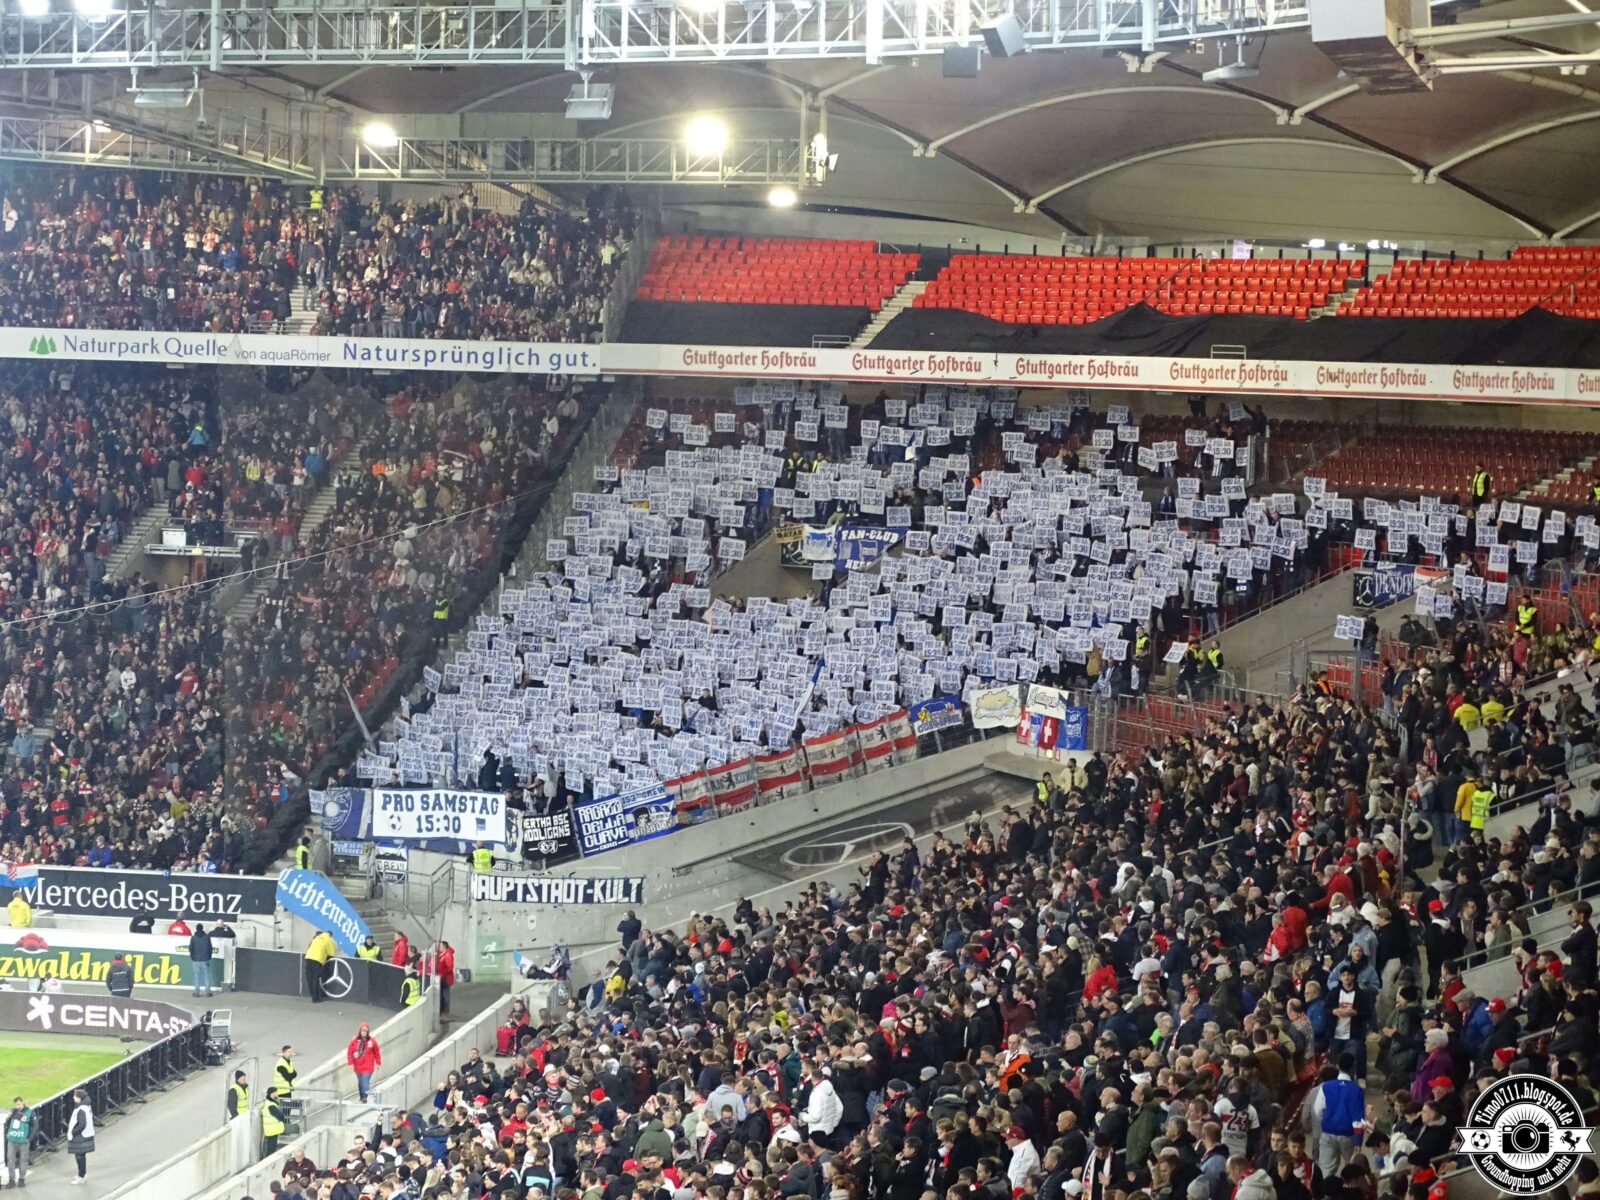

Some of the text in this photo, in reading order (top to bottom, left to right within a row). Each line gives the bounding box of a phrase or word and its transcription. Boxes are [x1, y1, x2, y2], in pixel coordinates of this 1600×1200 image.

[64, 334, 228, 358] Naturpark Quelle
[234, 346, 332, 364] von aquaRömer
[343, 339, 597, 372] Natursprünglich gut.
[683, 348, 816, 370] Stuttgarter Hofbräu
[852, 352, 982, 375] Stuttgarter Hofbräu
[1016, 358, 1138, 380] Stuttgarter Hofbräu
[1170, 362, 1288, 385] Stuttgarter Hofbräu
[1316, 366, 1426, 388] Stuttgarter Hofbräu
[1453, 368, 1509, 392] Stuttgarter
[1512, 370, 1554, 393] Hofbräu
[841, 530, 899, 544] FAN-CLUB
[381, 794, 499, 816] PRO SAMSTAG
[578, 798, 623, 823] RAGAZZI
[416, 814, 462, 834] 15:30
[552, 813, 569, 826] BSC
[582, 814, 626, 836] DELLA
[584, 826, 629, 848] CURVA
[278, 868, 366, 949] Lichtenrade
